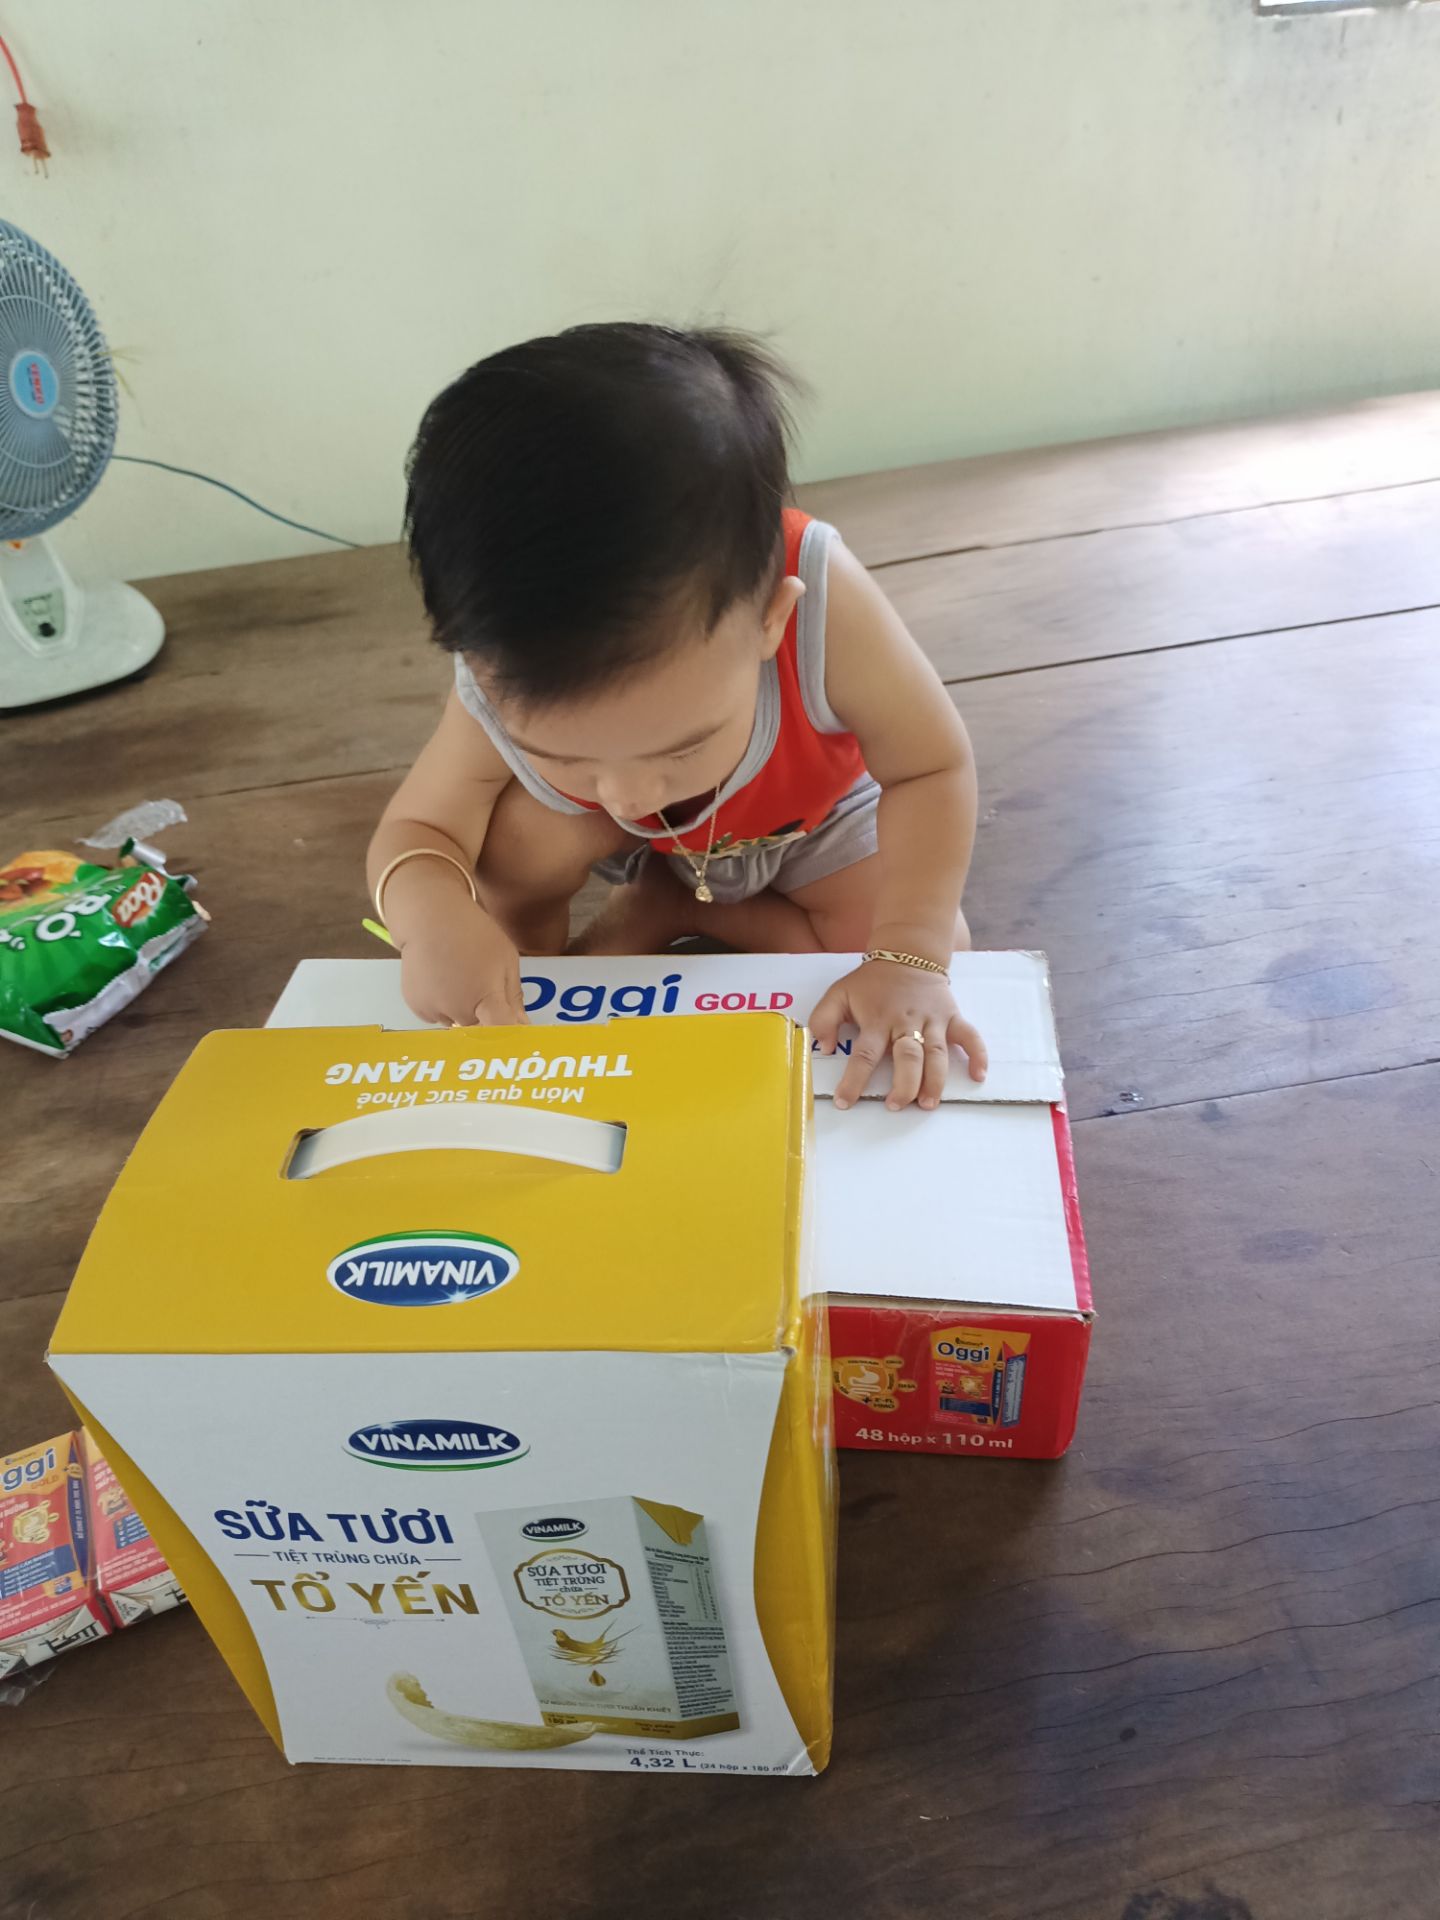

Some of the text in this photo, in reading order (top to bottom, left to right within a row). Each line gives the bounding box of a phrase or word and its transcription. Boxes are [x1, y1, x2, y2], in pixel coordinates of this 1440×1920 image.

[116, 871, 164, 922] Poca
[694, 992, 793, 1011] GOLD
[325, 1051, 632, 1085] THƯỢNG HẠNG
[531, 1086, 584, 1104] Món
[343, 1260, 496, 1287] VINAMILK
[938, 1342, 990, 1362] Oggi
[355, 1432, 513, 1452] VINAMILK
[855, 1427, 1013, 1449] 48 hộp x 110 ml
[2, 1448, 54, 1490] ggi
[214, 1500, 454, 1544] SỮA TƯƠI
[526, 1522, 581, 1534] VINAMILK
[274, 1549, 421, 1565] TIỆT TRÙNG CHỨA
[527, 1563, 607, 1577] SỮA TƯƠI
[250, 1571, 480, 1615] TỔ YẾN
[570, 1592, 610, 1606] YẾN
[630, 1757, 675, 1769] 4,32
[683, 1757, 696, 1768] L
